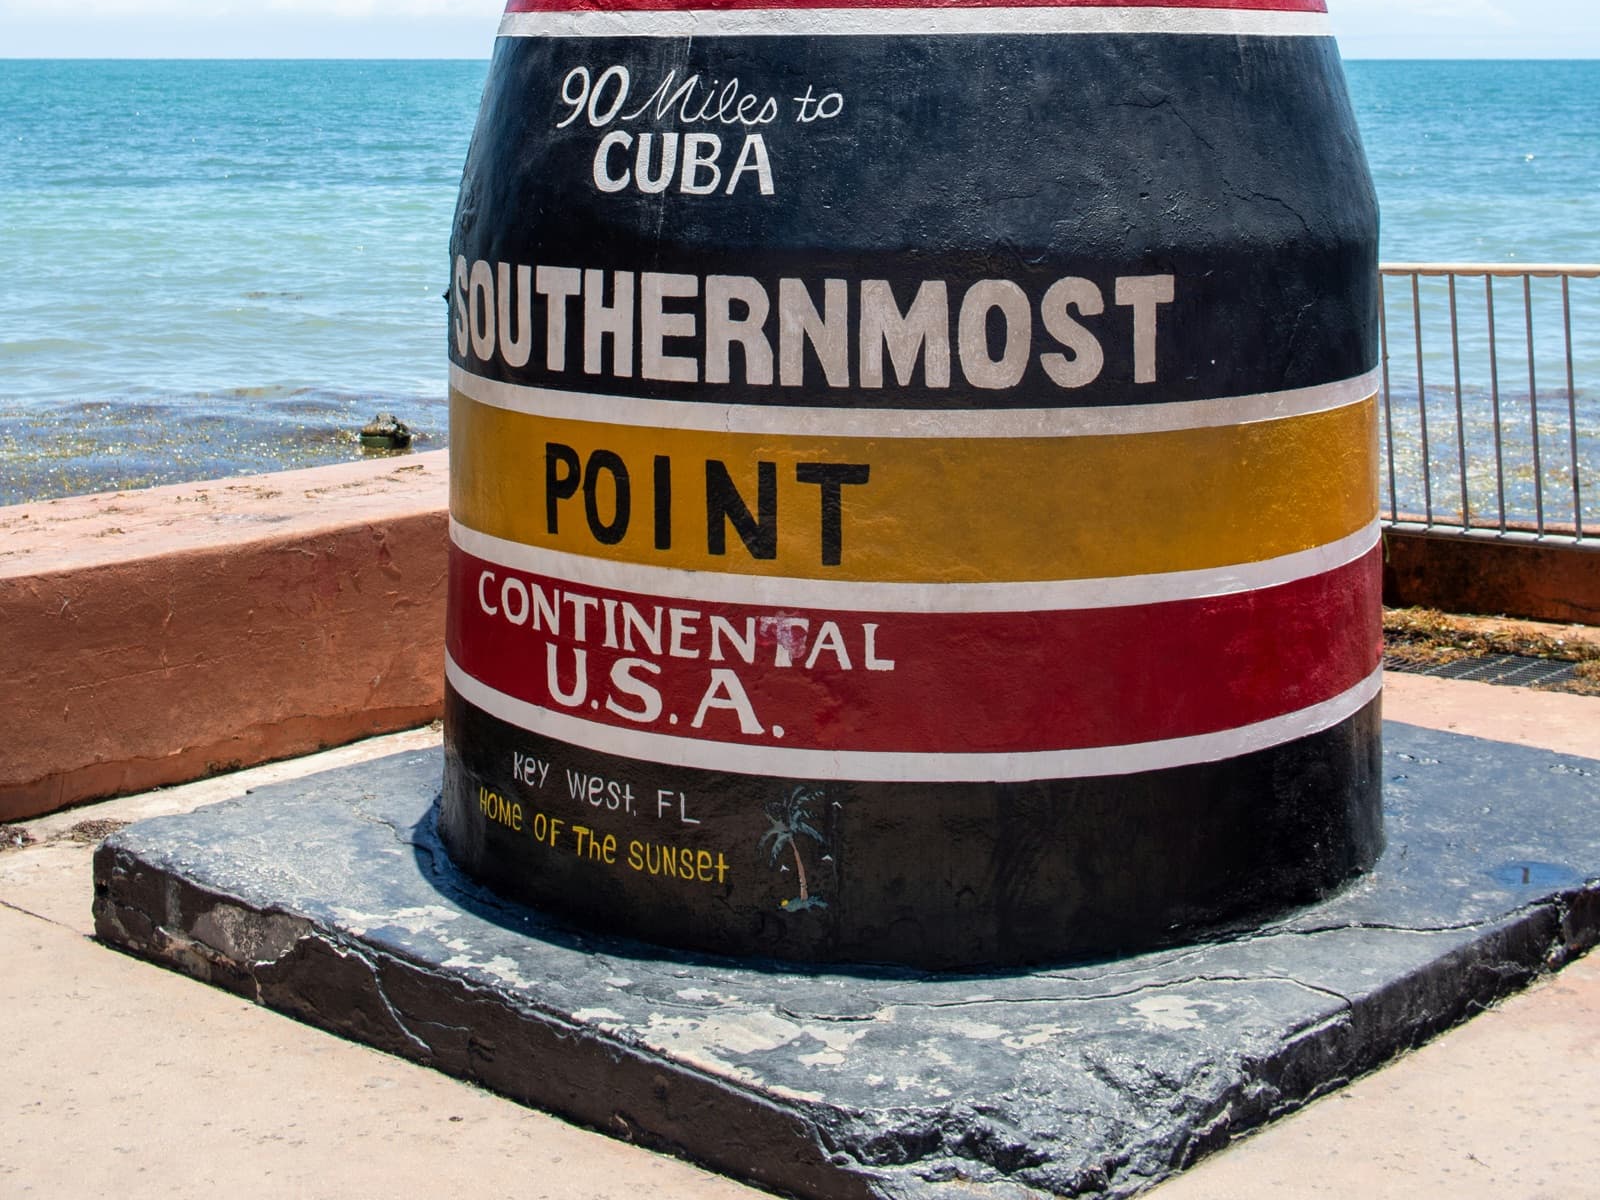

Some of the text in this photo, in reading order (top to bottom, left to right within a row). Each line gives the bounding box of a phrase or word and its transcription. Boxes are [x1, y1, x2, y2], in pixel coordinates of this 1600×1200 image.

[556, 65, 843, 129] 90 Miles to
[593, 129, 775, 196] CUBA
[455, 254, 1175, 390] SOUTHERNMOST
[544, 442, 870, 566] POINT
[478, 570, 896, 672] CONTINENTAL
[545, 641, 786, 739] U.S.A.
[533, 812, 566, 848] OF
[657, 789, 701, 825] FL
